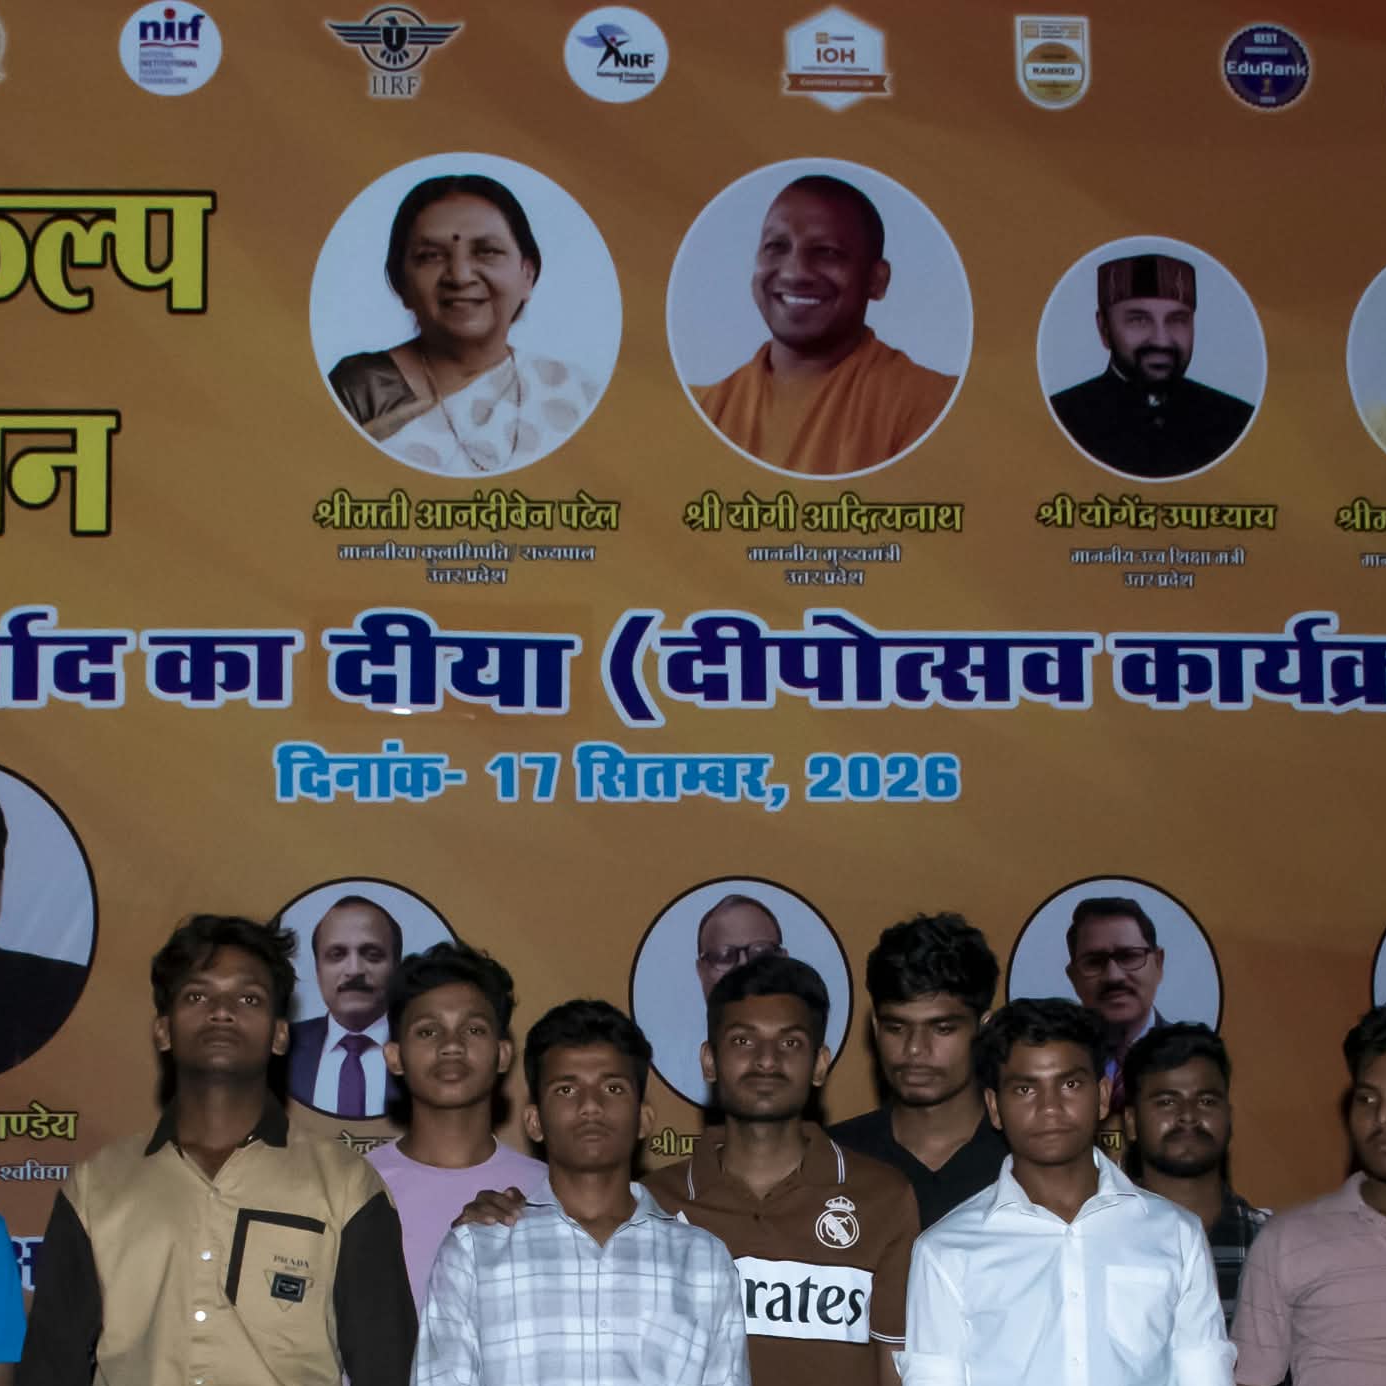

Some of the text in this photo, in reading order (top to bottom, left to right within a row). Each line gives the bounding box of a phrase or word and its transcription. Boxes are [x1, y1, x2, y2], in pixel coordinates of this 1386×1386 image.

[139, 8, 205, 41] nirf
[614, 53, 655, 68] NRF
[816, 48, 856, 64] IOH
[1226, 61, 1307, 76] EduRank
[371, 76, 420, 95] IIRF
[313, 489, 619, 531] श्रीमती आनंदीबेन पटेल
[684, 491, 965, 533] श्री योगी आदित्यनाथ
[1037, 493, 1278, 529] श्री योगेंद्र उपाध्याय
[520, 545, 596, 561] राज्यपाल
[426, 564, 508, 585] उत्तर प्रदेश
[785, 567, 865, 586] उत्तर प्रदेश
[1156, 570, 1195, 588] प्रदेश
[140, 627, 305, 710] का
[322, 608, 582, 715] दीया
[599, 608, 1104, 729] (दीपोत्सव
[273, 739, 961, 811] दिनांक- 17 सितम्बर, 2026
[650, 1127, 677, 1155] श्री
[744, 1276, 865, 1326] rates
